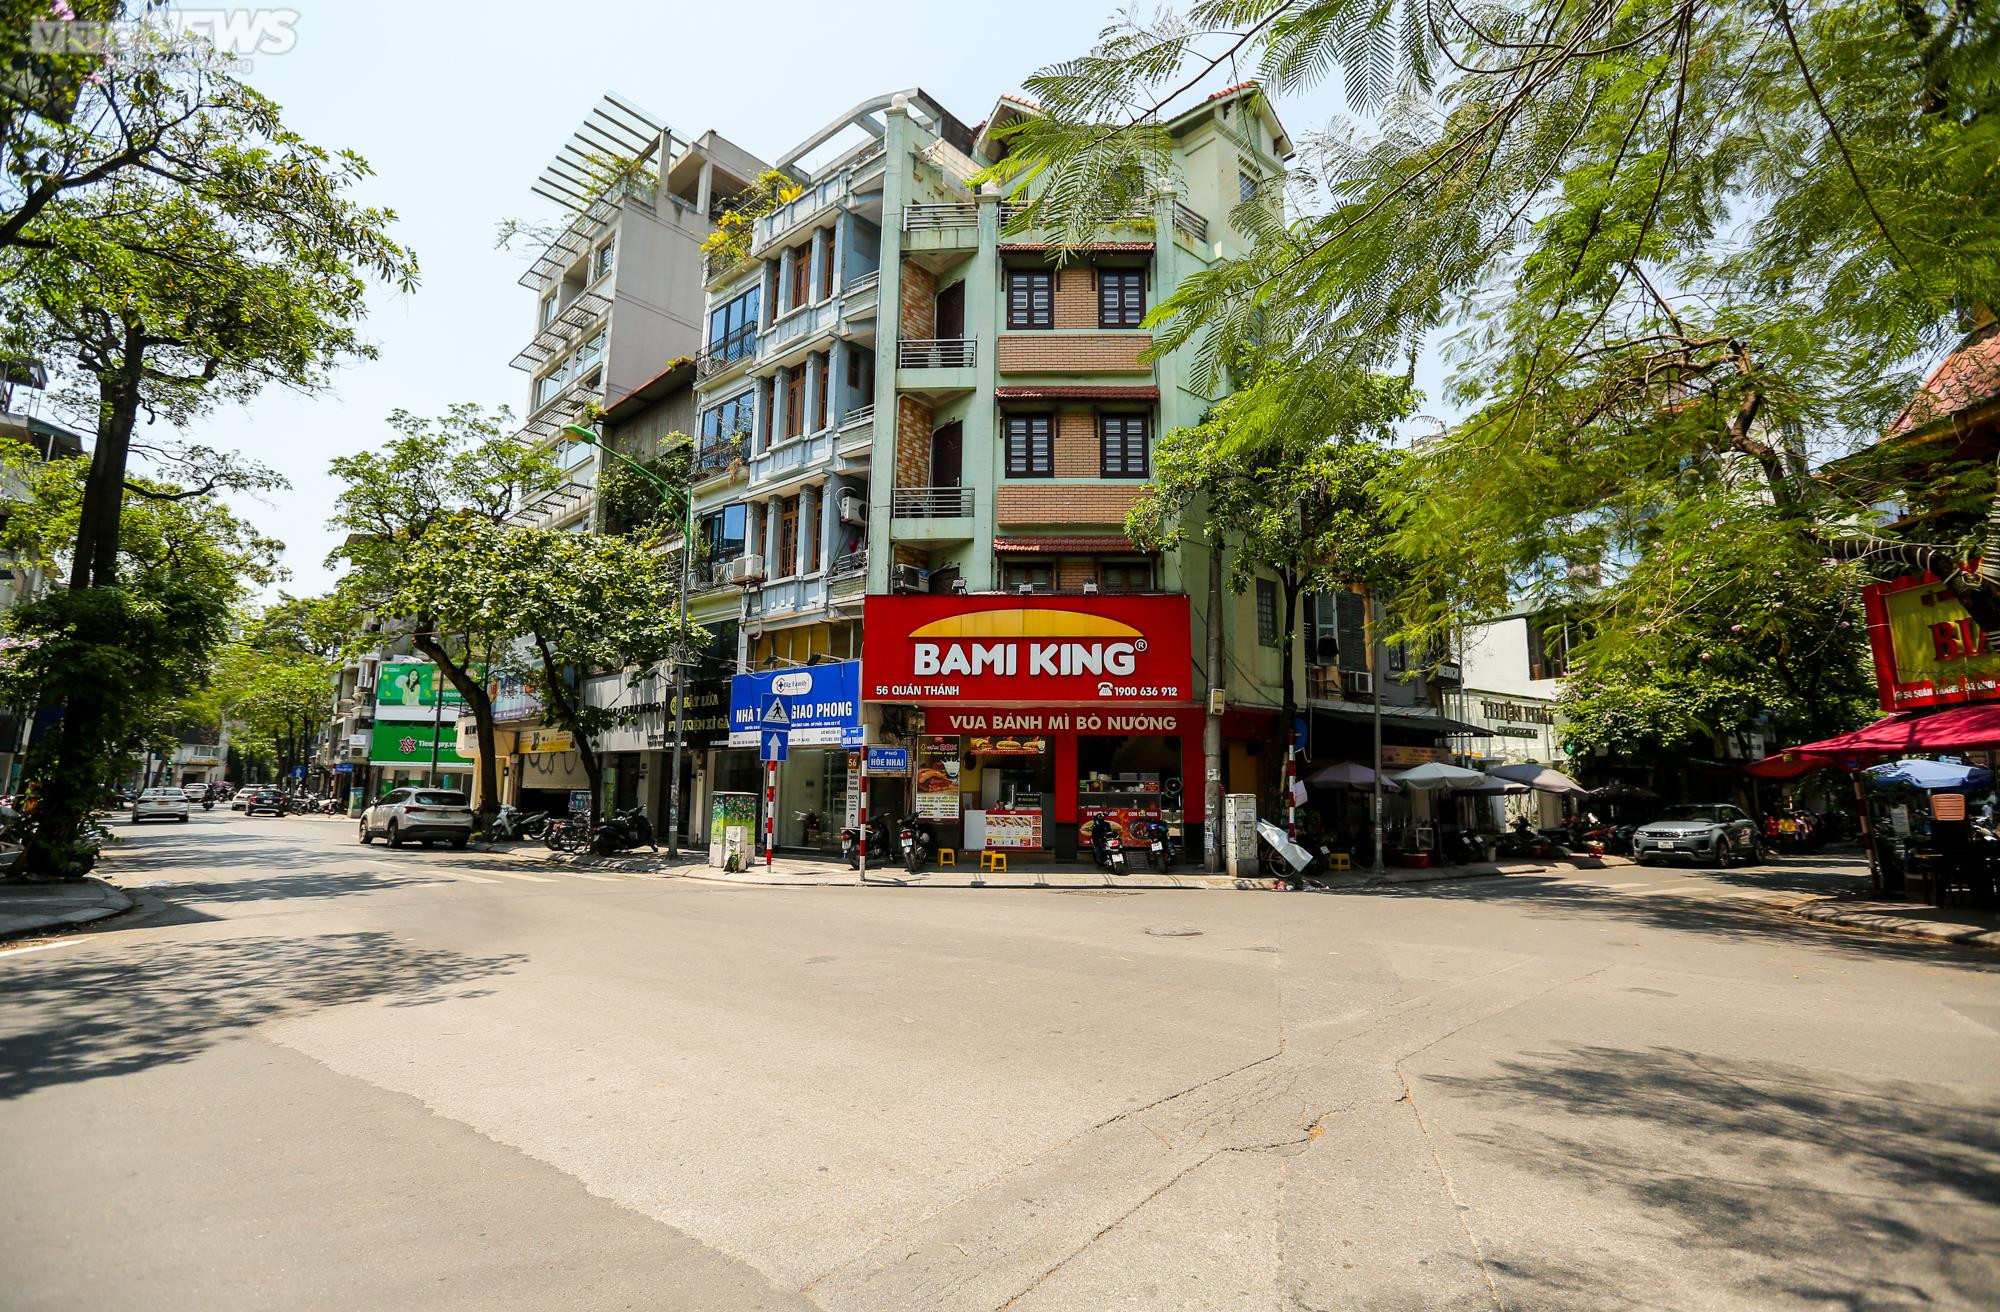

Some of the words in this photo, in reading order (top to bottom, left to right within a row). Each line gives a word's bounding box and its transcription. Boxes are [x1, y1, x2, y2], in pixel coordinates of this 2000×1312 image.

[914, 643, 1017, 675] BAMI
[876, 686, 888, 695] 56
[892, 683, 921, 697] QUÁN
[924, 683, 960, 695] THÁNH
[1115, 687, 1137, 696] 1900
[1140, 687, 1158, 696] 636
[1161, 687, 1178, 696] 912
[736, 705, 753, 723] NHÀ
[791, 704, 814, 720] GIAO
[817, 701, 852, 718] PHONG
[1481, 699, 1521, 724] THIỆN
[950, 715, 987, 729] VUA
[992, 712, 1043, 729] BÁNH
[1048, 713, 1070, 730] MÌ
[1076, 713, 1101, 730] BÒ
[1107, 713, 1177, 730] NƯỚNG
[848, 758, 857, 767] 56
[886, 758, 904, 767] NHAI
